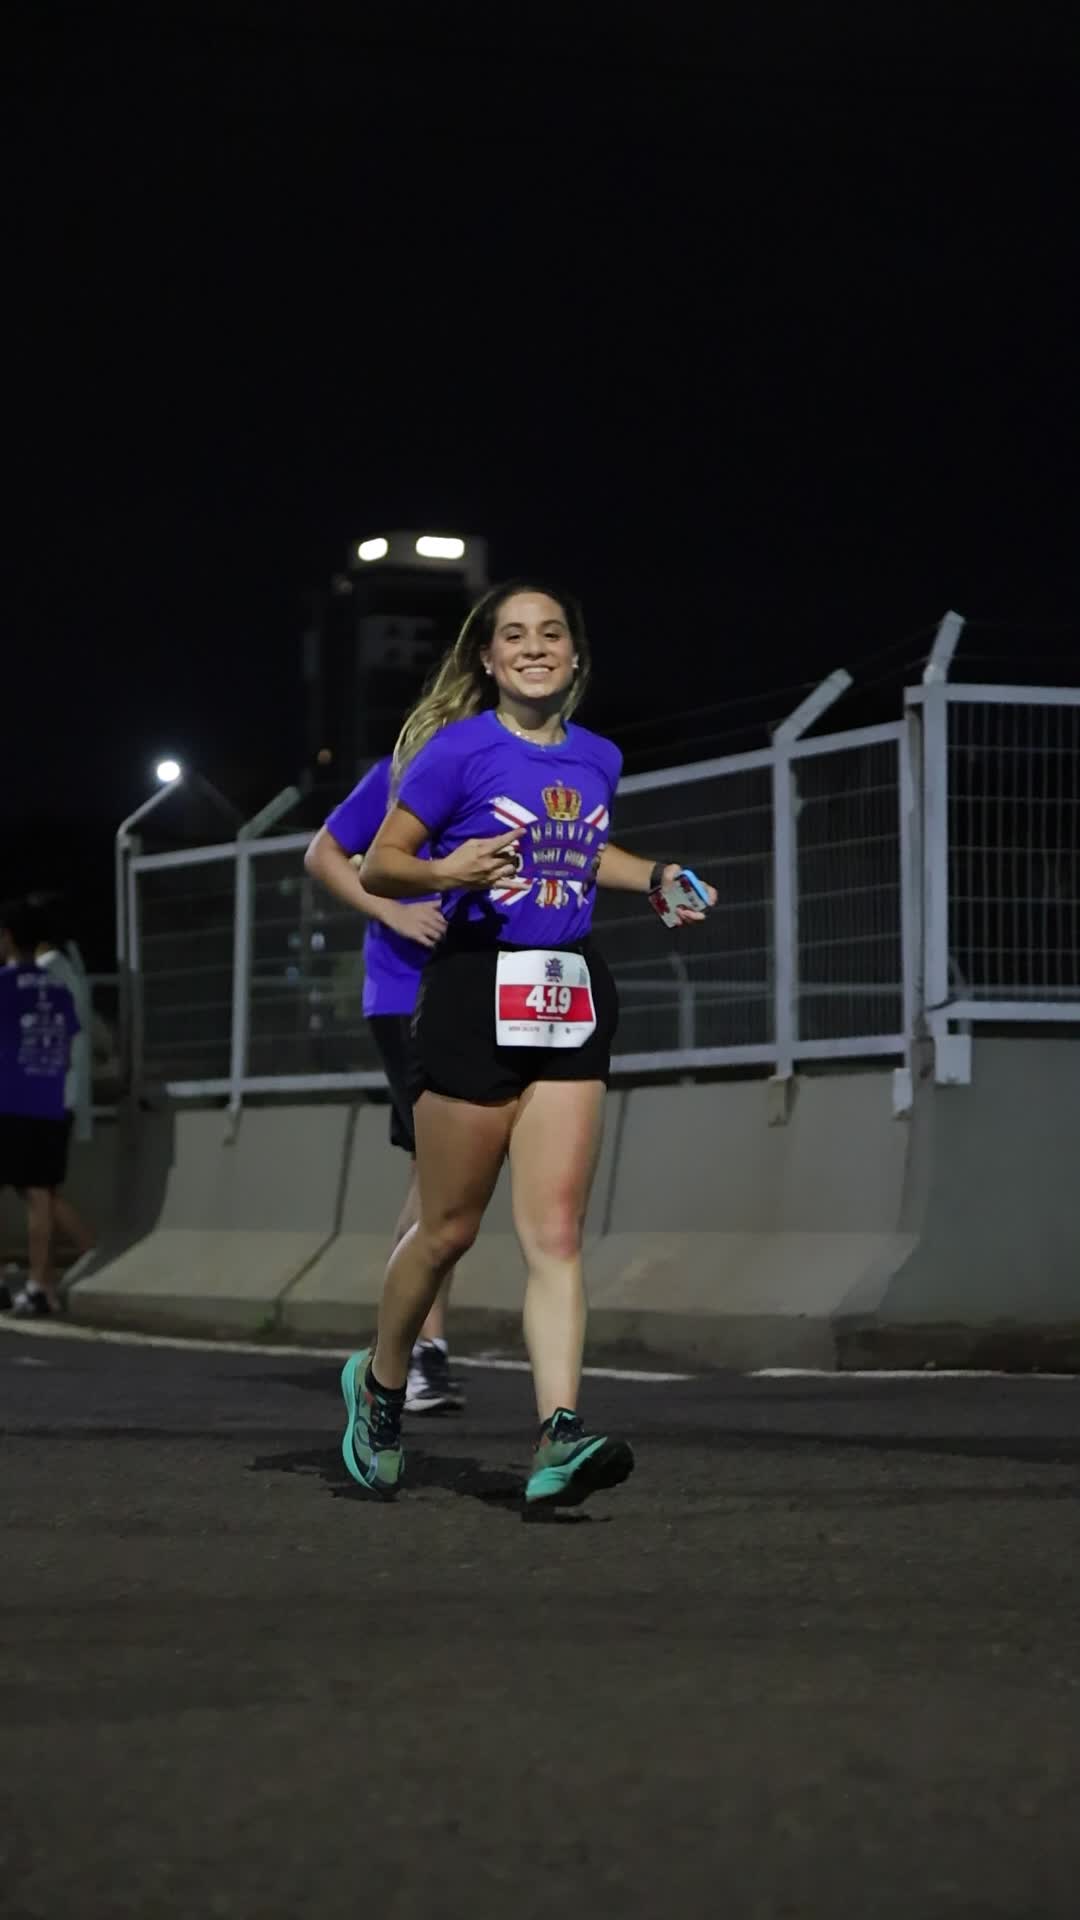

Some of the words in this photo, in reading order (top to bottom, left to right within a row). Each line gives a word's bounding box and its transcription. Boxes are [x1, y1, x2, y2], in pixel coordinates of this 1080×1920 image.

[531, 822, 594, 845] MARVIN
[532, 848, 561, 864] NIGHT
[525, 985, 572, 1014] 419
